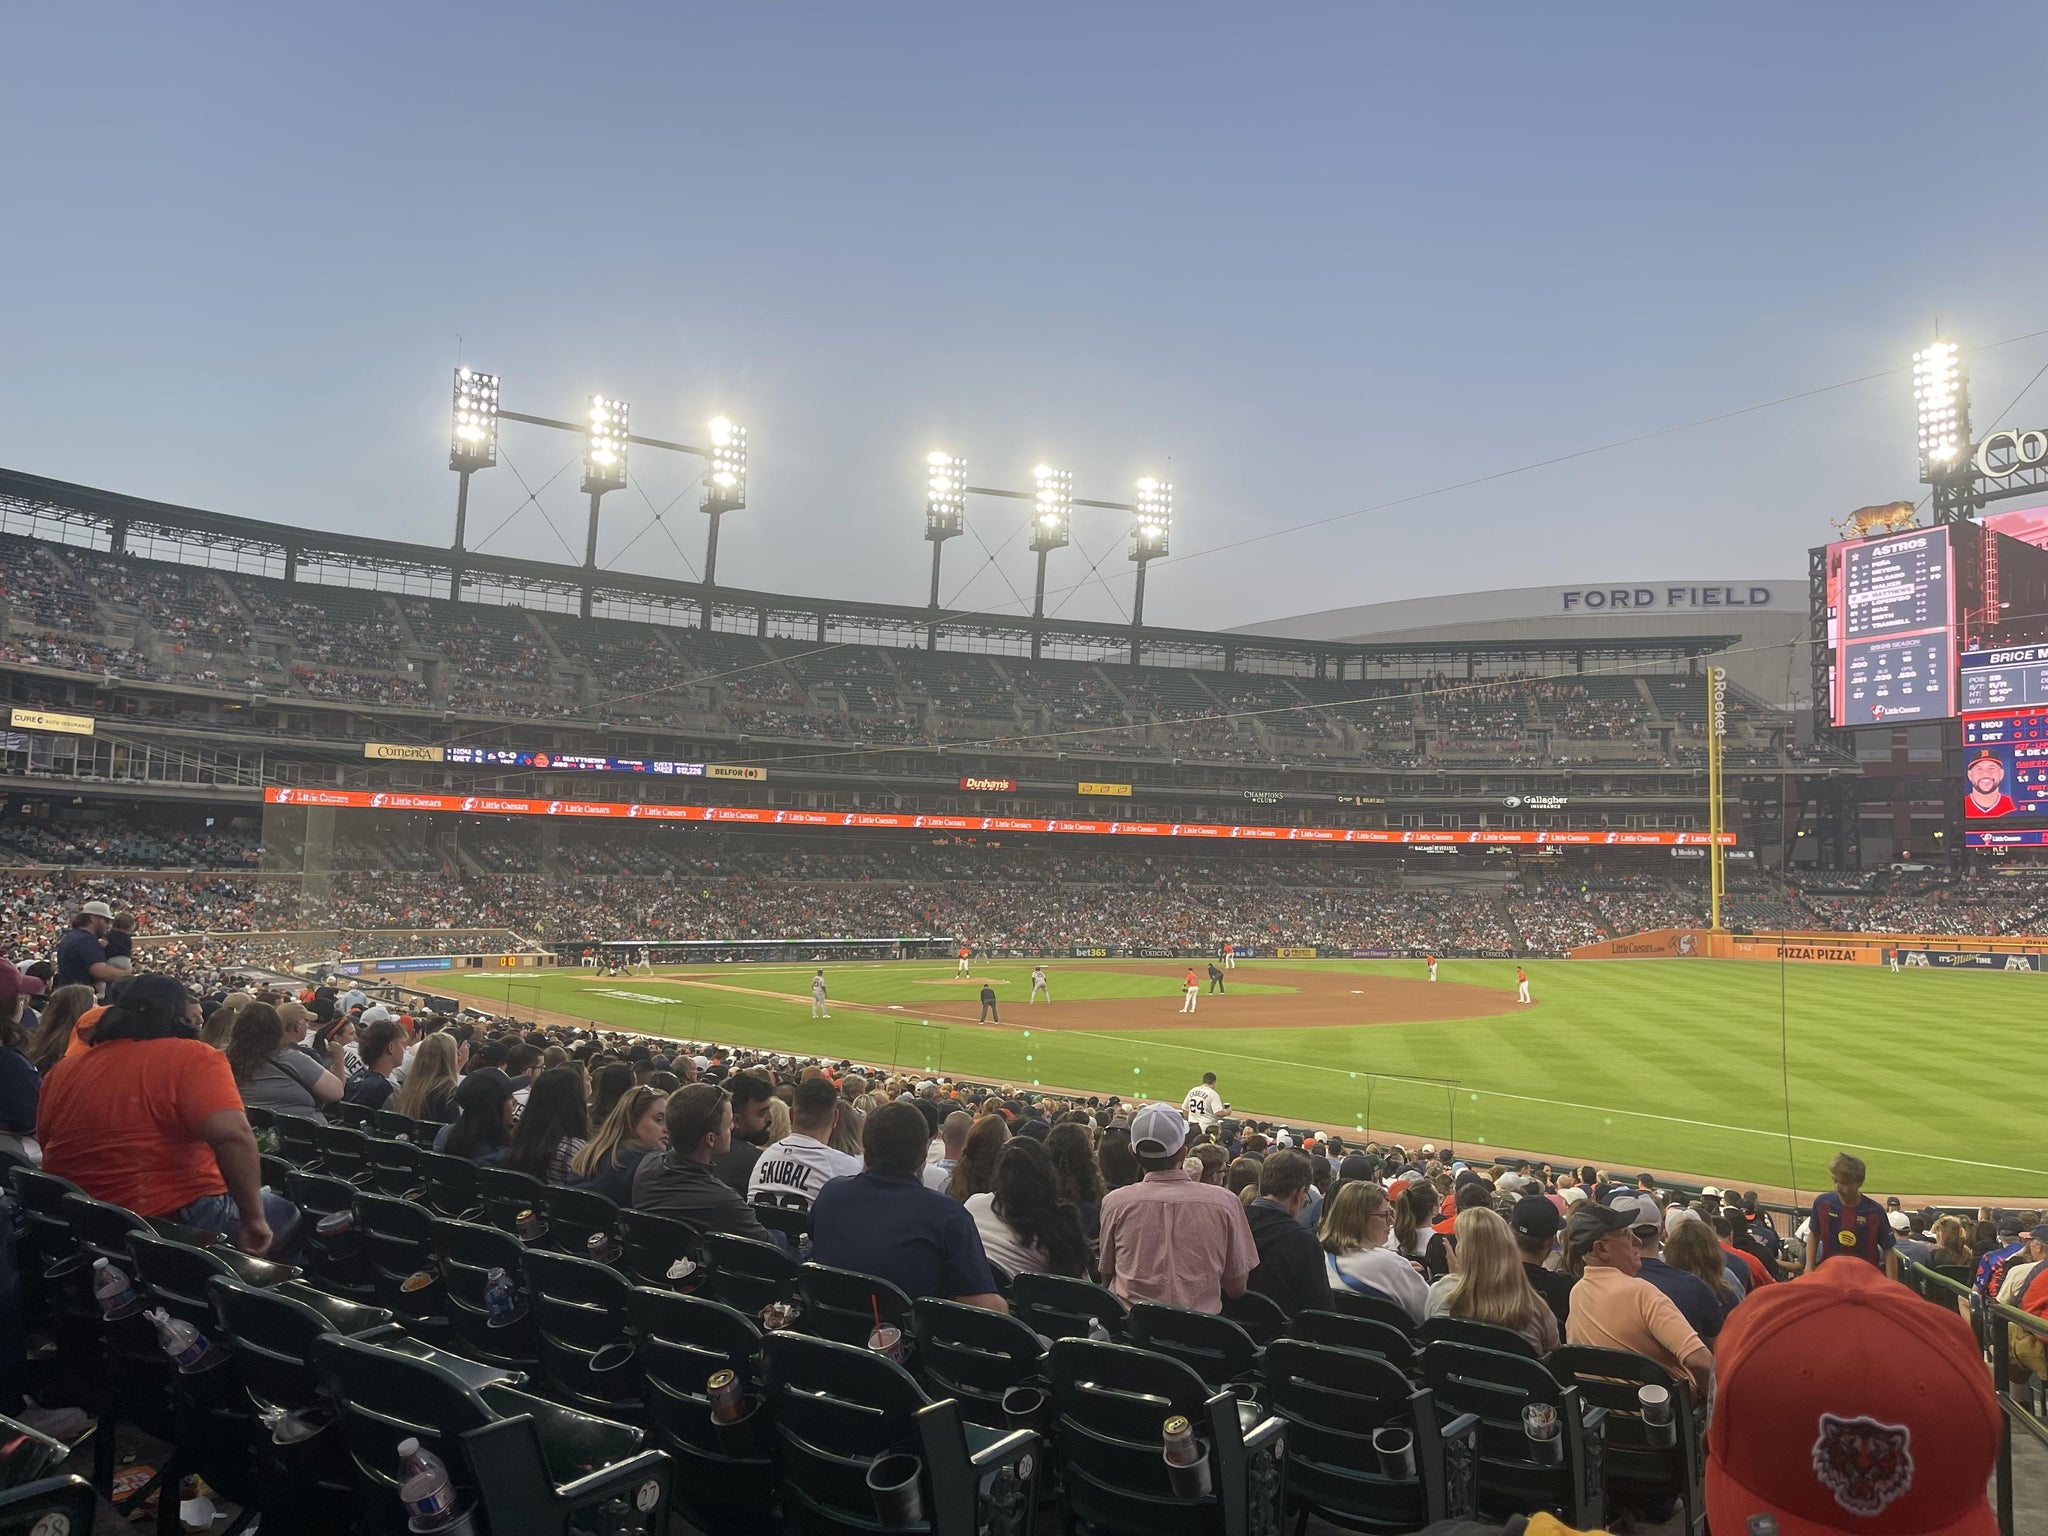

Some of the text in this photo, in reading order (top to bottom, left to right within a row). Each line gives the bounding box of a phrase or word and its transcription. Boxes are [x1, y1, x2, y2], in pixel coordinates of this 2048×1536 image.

[1872, 538, 1927, 557] ASTROS
[1872, 566, 1901, 576] MEYERS
[1872, 573, 1905, 583] DELGADO
[1872, 581, 1901, 591] WALKER
[1872, 587, 1912, 598] MATTHEWS
[1562, 587, 1772, 611] FORD FIELD
[1872, 618, 1911, 629] TRAMMELL
[1892, 639, 1921, 649] SEASON
[1990, 649, 2035, 664] BRICE
[15, 714, 37, 723] CURE
[62, 721, 92, 729] INSURANCE
[1981, 720, 2003, 729] HOU
[1982, 733, 2003, 741] DET
[563, 756, 606, 764] MATTHEWS
[715, 769, 744, 777] BELFOR
[966, 778, 1009, 790] Dunham's
[1244, 790, 1284, 799] CHAMPIONS
[391, 795, 442, 807] Little Caesars
[481, 800, 529, 811] Little Caesars
[1524, 796, 1568, 805] Gallagher
[565, 804, 610, 814] Little Caesars
[644, 807, 686, 817] Little Caesars
[720, 809, 759, 820] Little Caesars
[789, 813, 827, 823] Little Caesars
[859, 816, 898, 825] Little Caesars
[928, 818, 966, 827] Little Caesars
[995, 820, 1032, 829] Little Caesars
[1075, 823, 1095, 831] Caesars
[1137, 825, 1157, 833] Caesars
[1621, 834, 1636, 842] Little
[1076, 948, 1106, 957] bet365
[1777, 947, 1856, 962] PIZZA! PIZZA!
[1949, 953, 1981, 967] Miller
[1976, 957, 1992, 965] TIME
[1190, 1099, 1205, 1115] 24
[759, 1160, 812, 1191] SKUBAL
[1021, 1458, 1031, 1476] 26
[640, 1485, 657, 1508] 27
